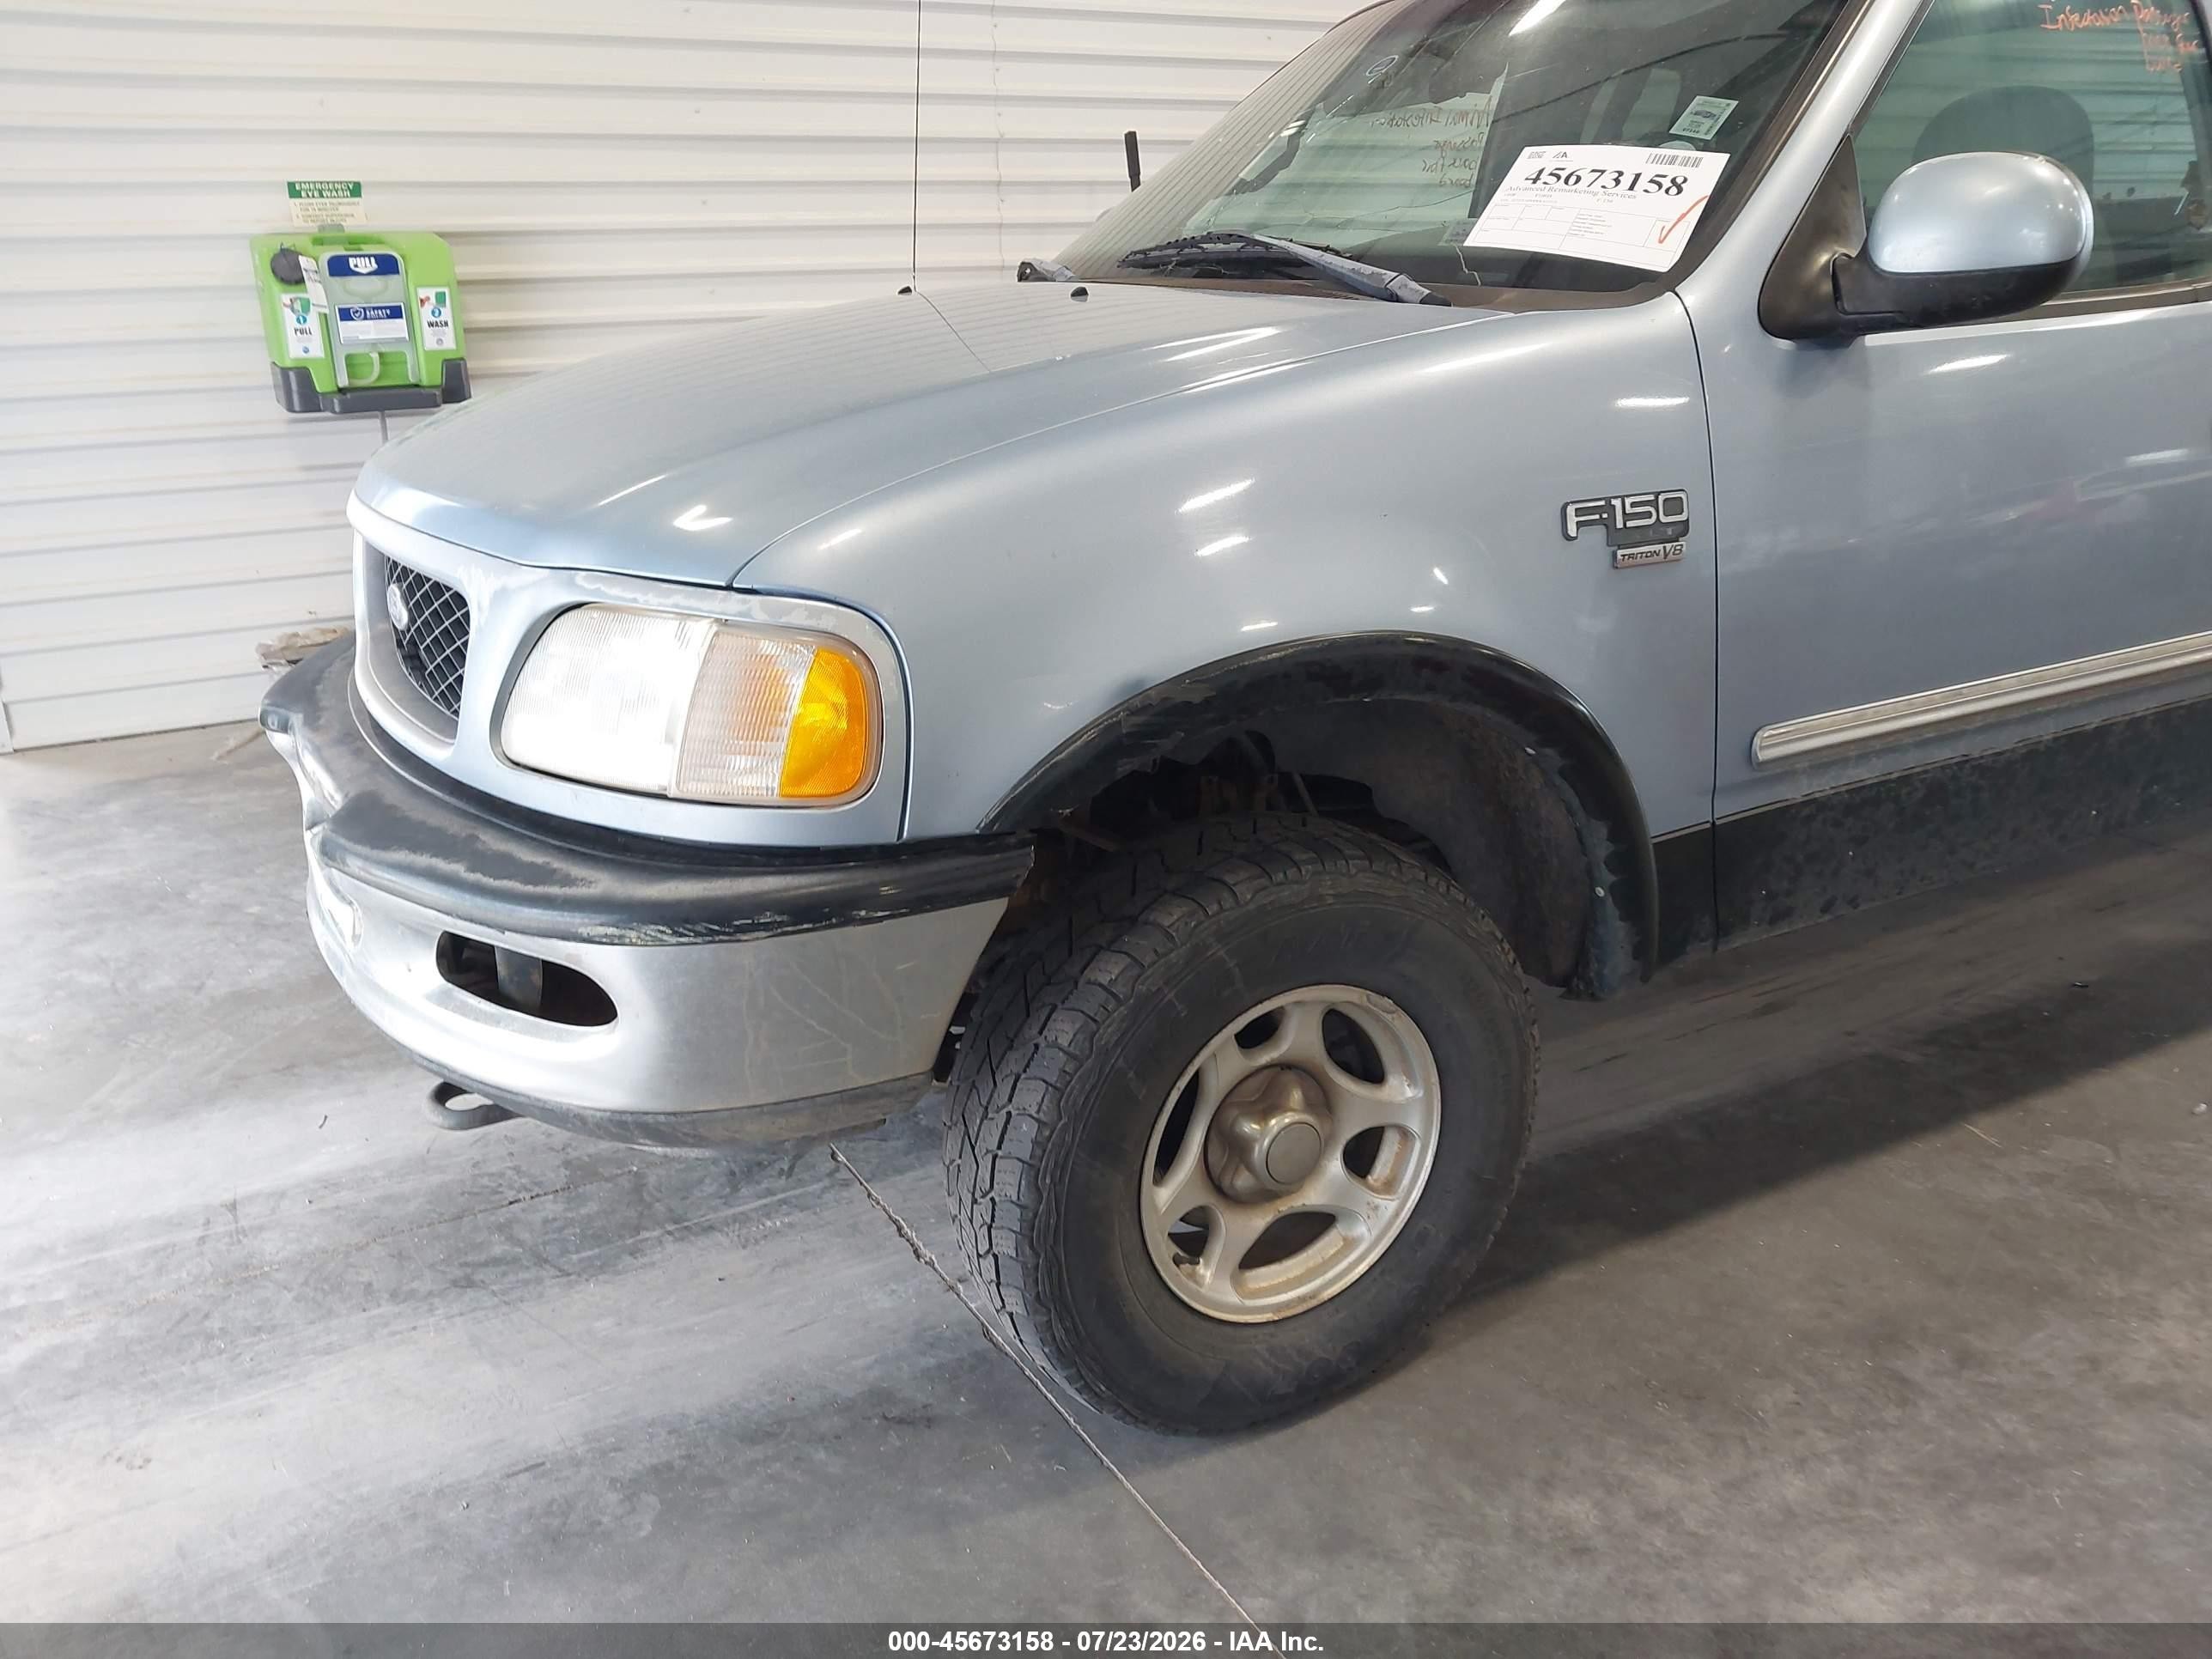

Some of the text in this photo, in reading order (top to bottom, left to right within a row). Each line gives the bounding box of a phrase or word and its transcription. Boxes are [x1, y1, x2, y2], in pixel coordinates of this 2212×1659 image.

[295, 181, 354, 191] EMERGENCY
[1524, 166, 1689, 197] 45673158
[301, 190, 351, 198] EYE WASH
[1547, 185, 1600, 198] Remarketing
[1601, 190, 1637, 200] Services
[348, 257, 379, 269] PULL
[427, 319, 449, 329] WASH
[294, 326, 313, 336] PULL
[1565, 490, 1689, 538] F-150
[1620, 544, 1684, 562] TRITON V8
